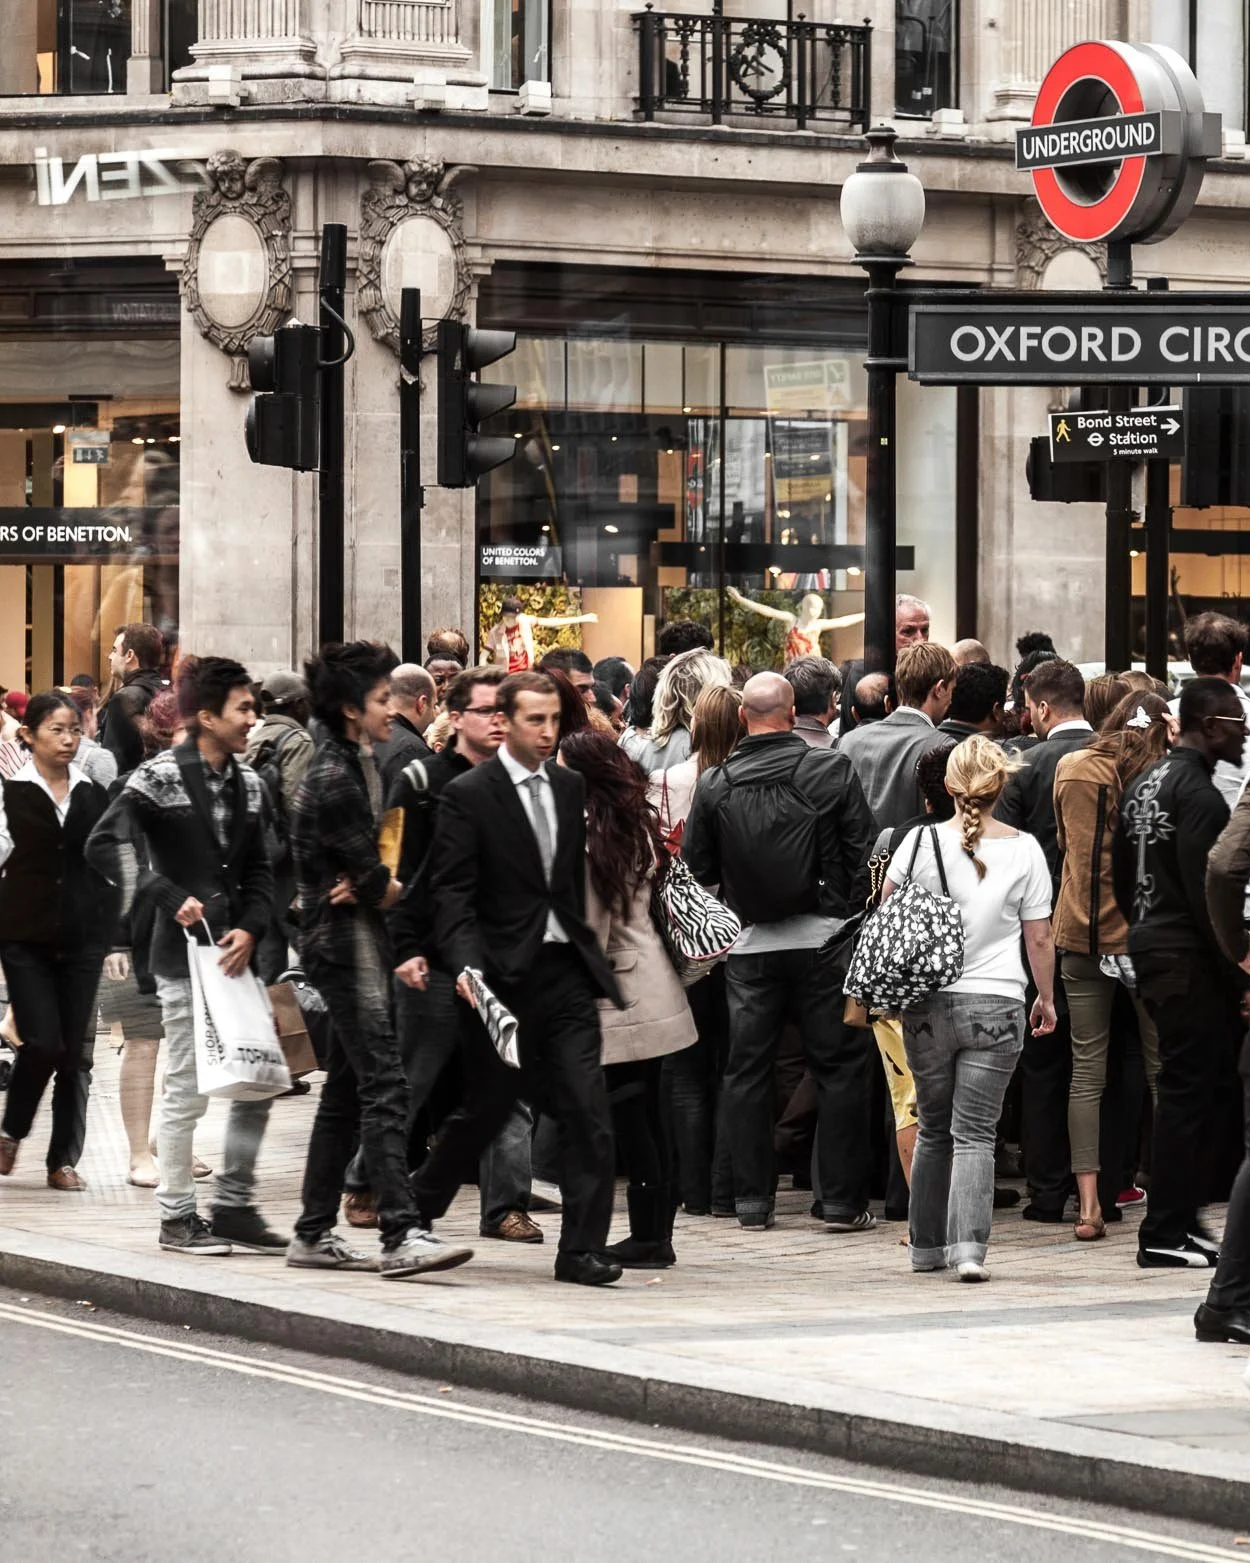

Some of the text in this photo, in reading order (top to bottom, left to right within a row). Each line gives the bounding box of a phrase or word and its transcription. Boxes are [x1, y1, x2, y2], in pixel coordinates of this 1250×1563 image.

[1022, 122, 1156, 160] UNDERGROUND
[950, 325, 1142, 363] OXFORD
[1077, 414, 1158, 429] Bond Street
[1109, 431, 1158, 445] Station
[22, 526, 44, 542] OF
[47, 526, 132, 542] BENETTON.
[482, 547, 546, 557] UNITED COLORS
[482, 557, 539, 565] OF BENETTON.
